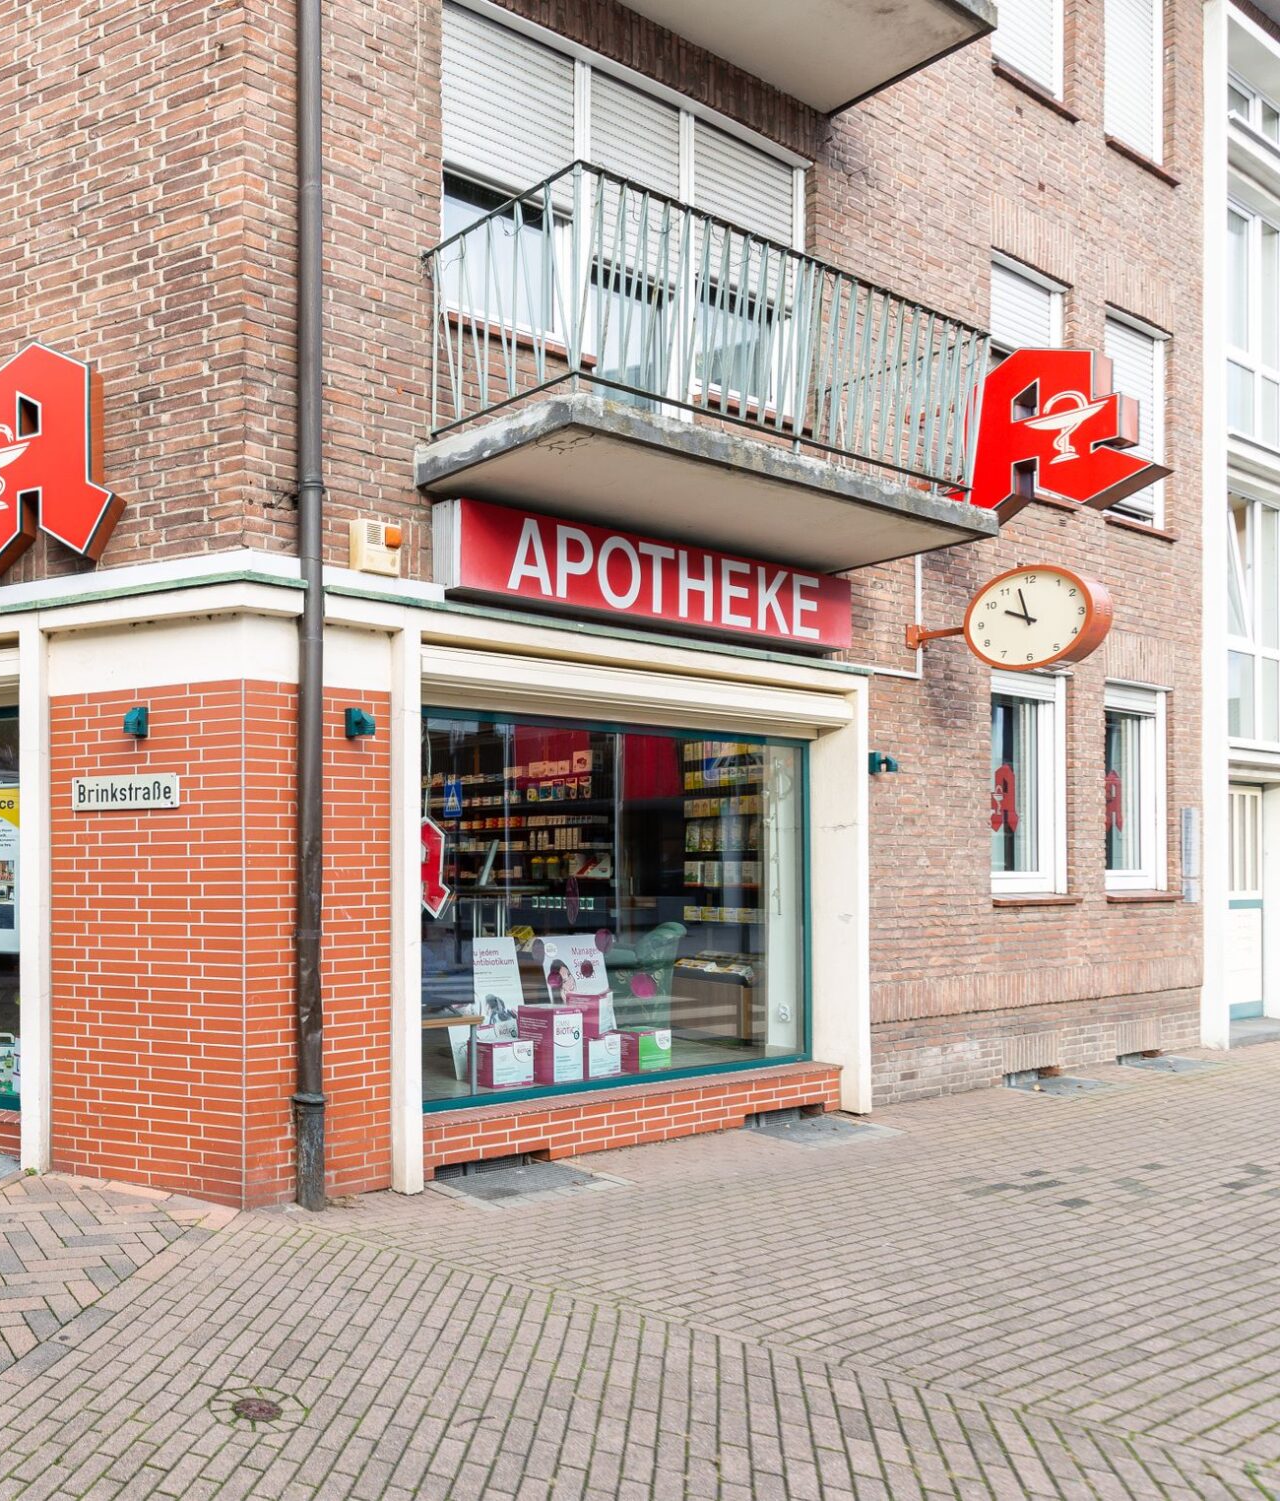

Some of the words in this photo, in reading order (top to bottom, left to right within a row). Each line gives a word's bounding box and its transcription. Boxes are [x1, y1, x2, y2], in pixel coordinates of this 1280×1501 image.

[507, 517, 820, 640] APOTHEKE
[1024, 575, 1037, 585] 12
[1055, 578, 1062, 587] 1
[999, 587, 1010, 596] 11
[1068, 588, 1076, 597] 2
[985, 601, 998, 610] 10
[1077, 606, 1086, 616] 3
[977, 621, 985, 630] 9
[1071, 627, 1079, 635] 4
[983, 639, 991, 648] 8
[1052, 643, 1061, 652] 5
[1000, 650, 1008, 659] 7
[1026, 652, 1034, 662] 6
[77, 780, 172, 804] Brinkstraße
[479, 948, 499, 958] jedem
